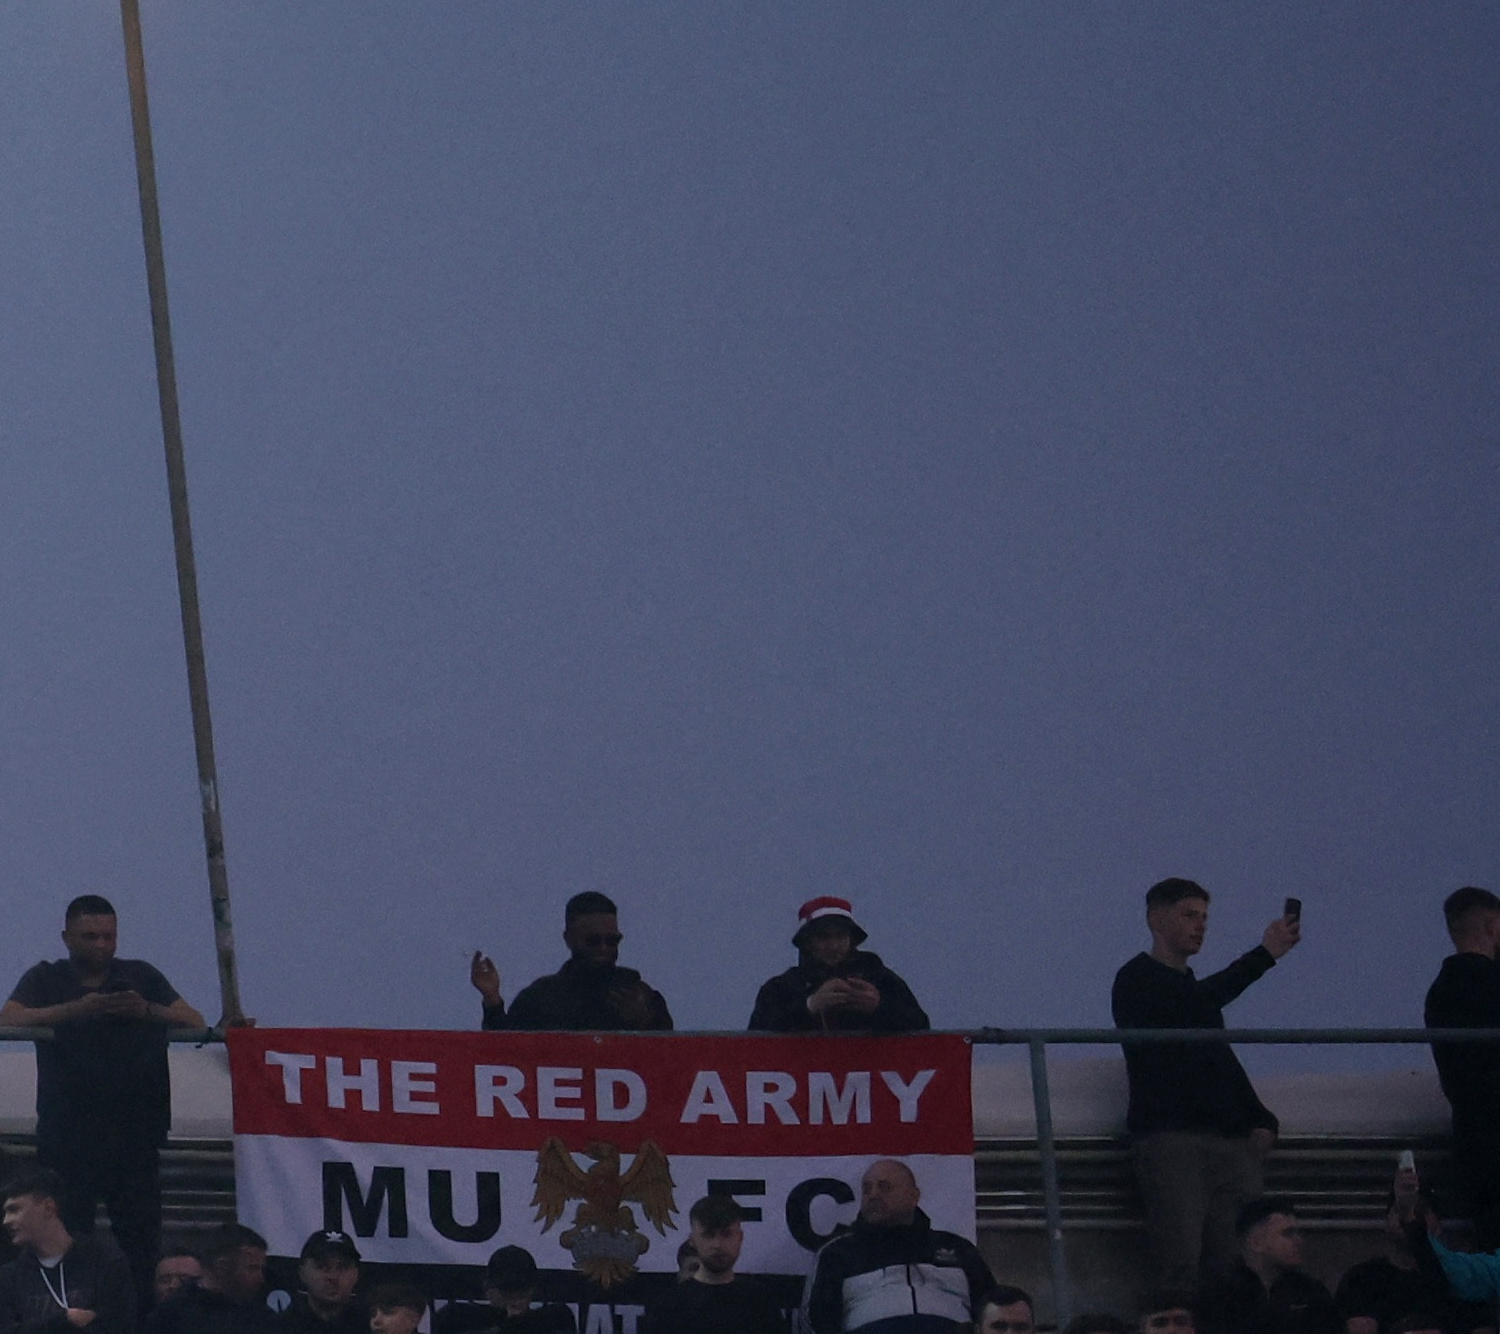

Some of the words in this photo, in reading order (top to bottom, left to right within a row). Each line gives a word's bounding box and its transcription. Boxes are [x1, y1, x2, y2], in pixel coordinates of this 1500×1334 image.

[264, 1051, 440, 1116] THE
[474, 1064, 648, 1122] RED
[679, 1069, 936, 1126] ARMY
[322, 1161, 501, 1243] MU
